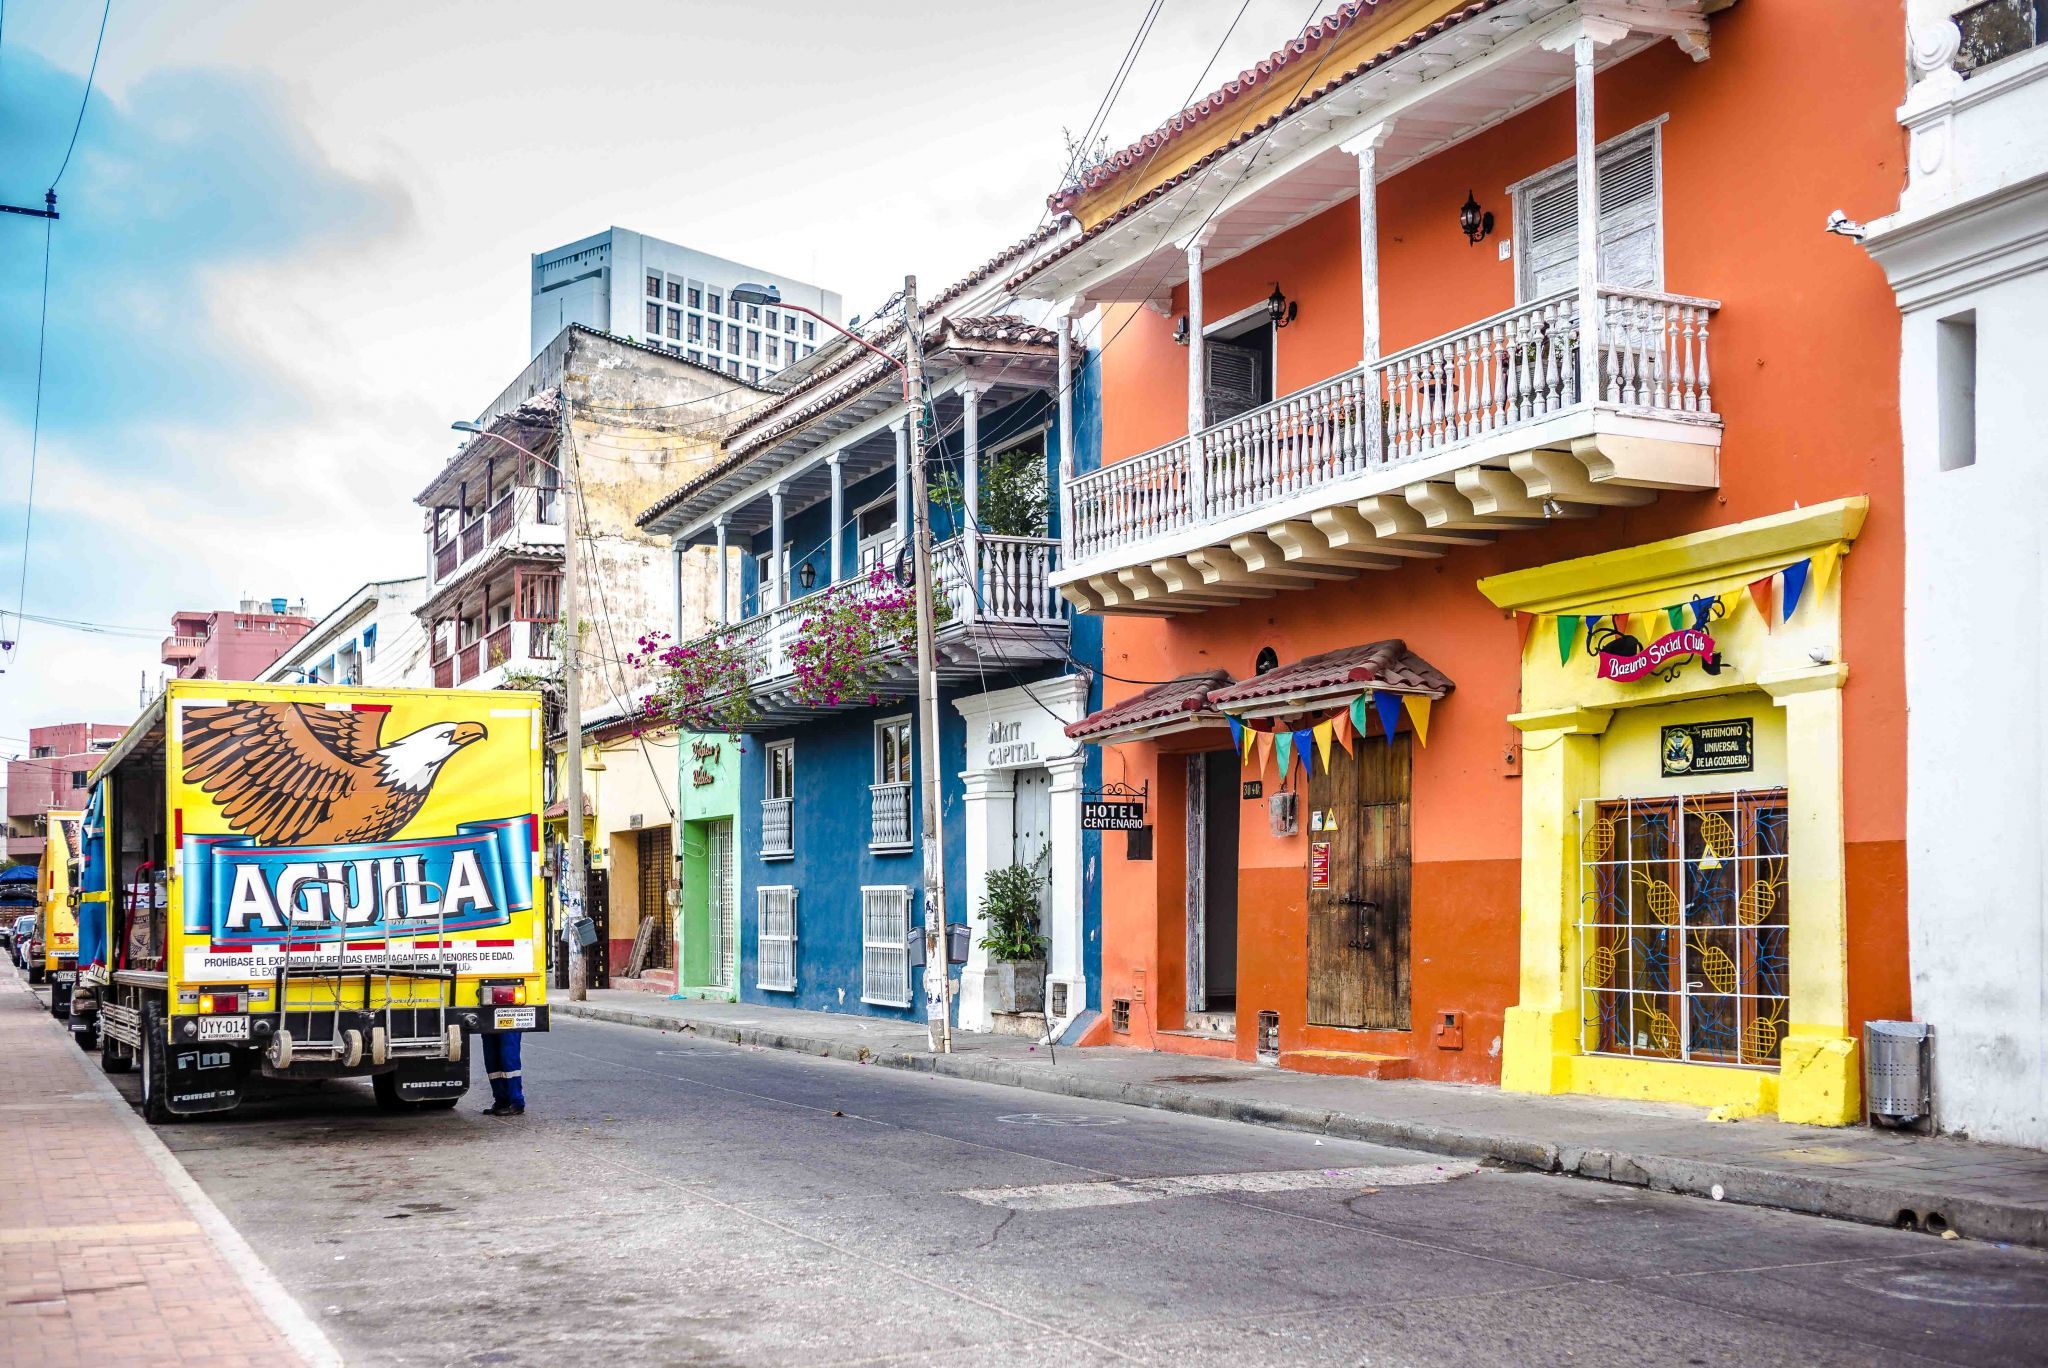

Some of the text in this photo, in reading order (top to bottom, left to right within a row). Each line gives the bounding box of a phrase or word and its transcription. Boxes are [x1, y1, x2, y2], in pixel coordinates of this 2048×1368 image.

[1609, 633, 1705, 677] Bazurto Social Club
[1701, 726, 1743, 739] PATRIMONIO
[1704, 741, 1739, 753] UNIVERSAL
[988, 742, 1038, 766] CAPITAL
[1696, 755, 1747, 768] DE LA GOZADERA
[1085, 805, 1138, 818] HOTEL
[1083, 818, 1143, 829] CENTENARIO
[224, 849, 500, 931] AGUILA
[204, 955, 254, 967] PROHÍBASE
[256, 956, 267, 966] EL
[479, 952, 490, 961] DE
[491, 951, 515, 960] EDAD.
[250, 967, 260, 976] EL
[200, 1020, 247, 1034] UYY-014
[402, 1080, 463, 1089] romarco
[173, 1089, 235, 1102] romarco
